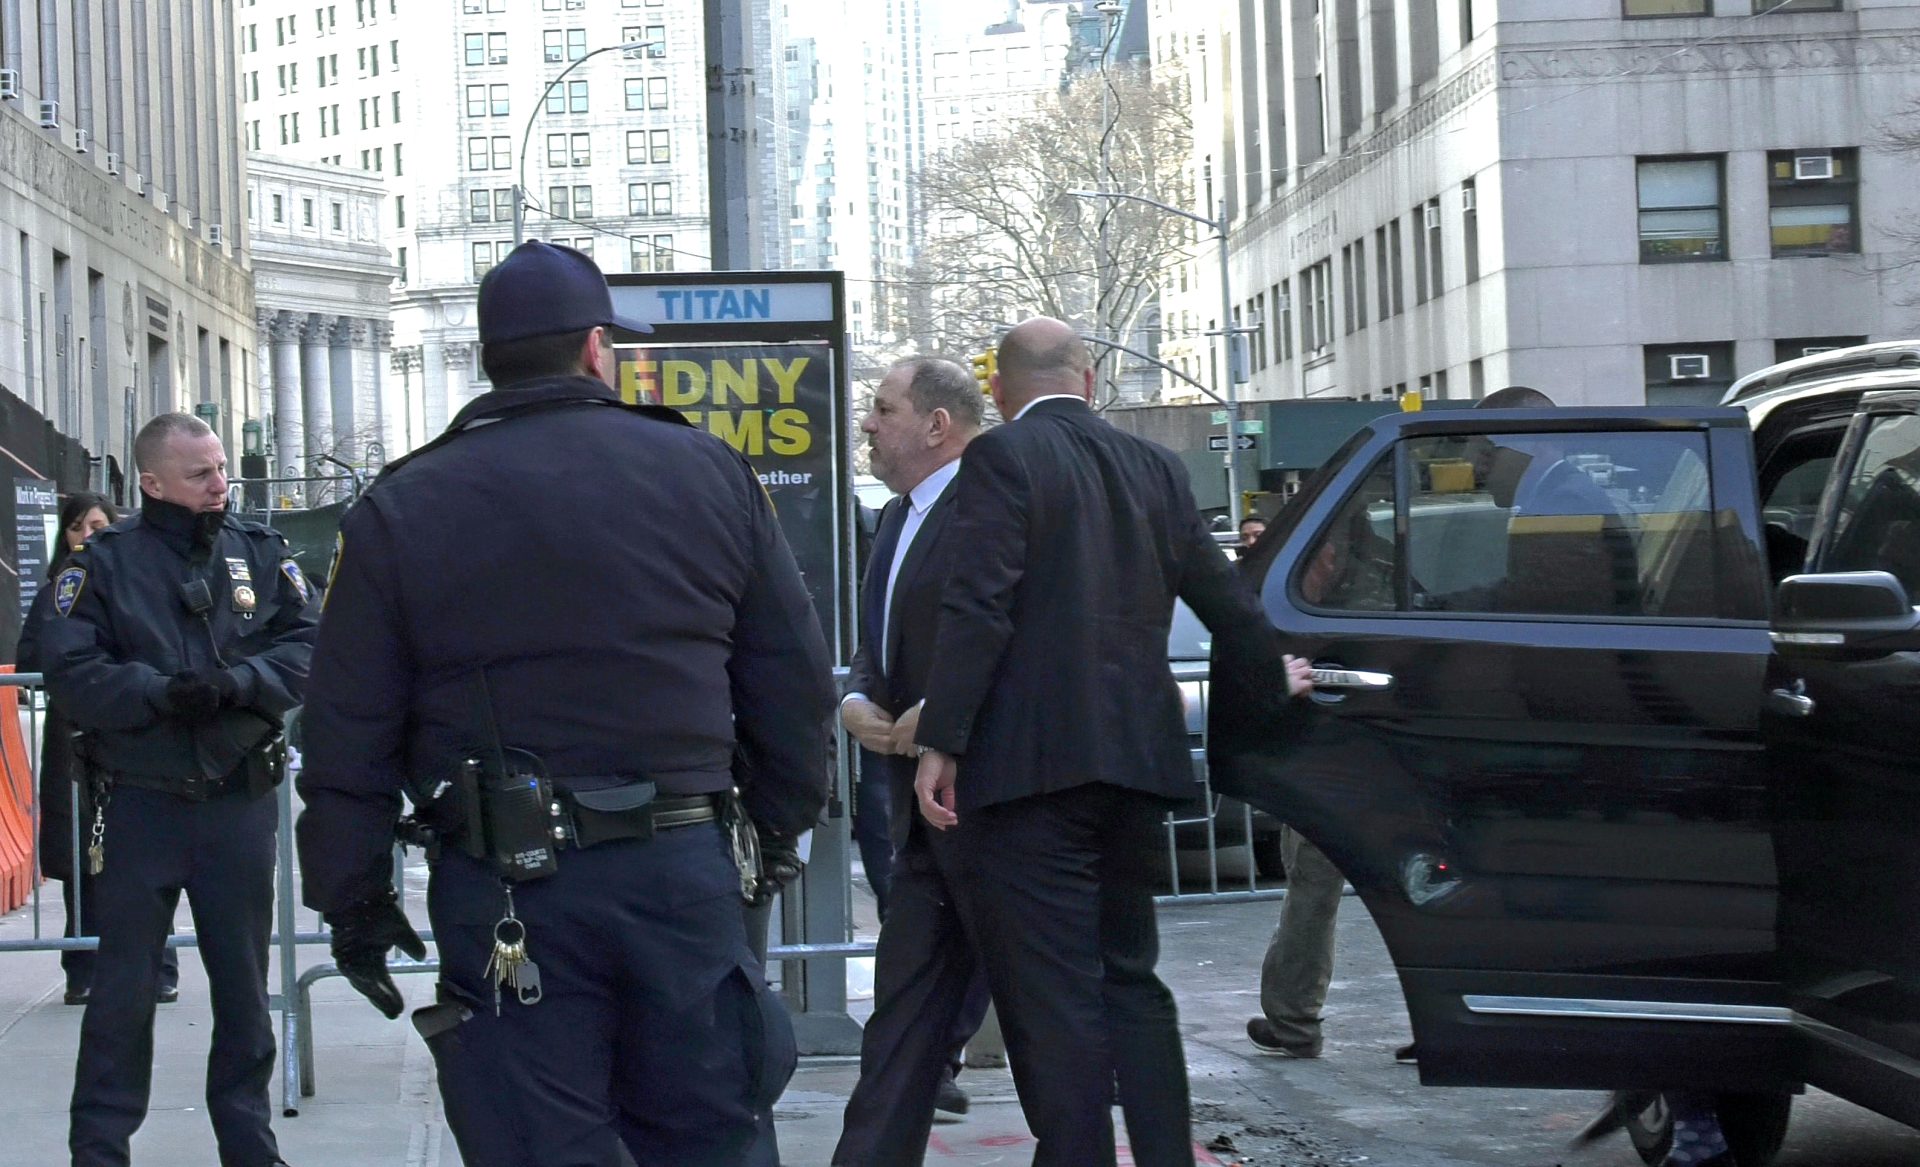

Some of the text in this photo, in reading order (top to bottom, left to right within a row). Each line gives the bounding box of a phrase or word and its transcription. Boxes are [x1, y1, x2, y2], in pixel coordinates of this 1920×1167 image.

[657, 288, 770, 320] TITAN
[619, 357, 810, 406] FDNY
[681, 408, 811, 455] MS
[757, 470, 812, 485] ether
